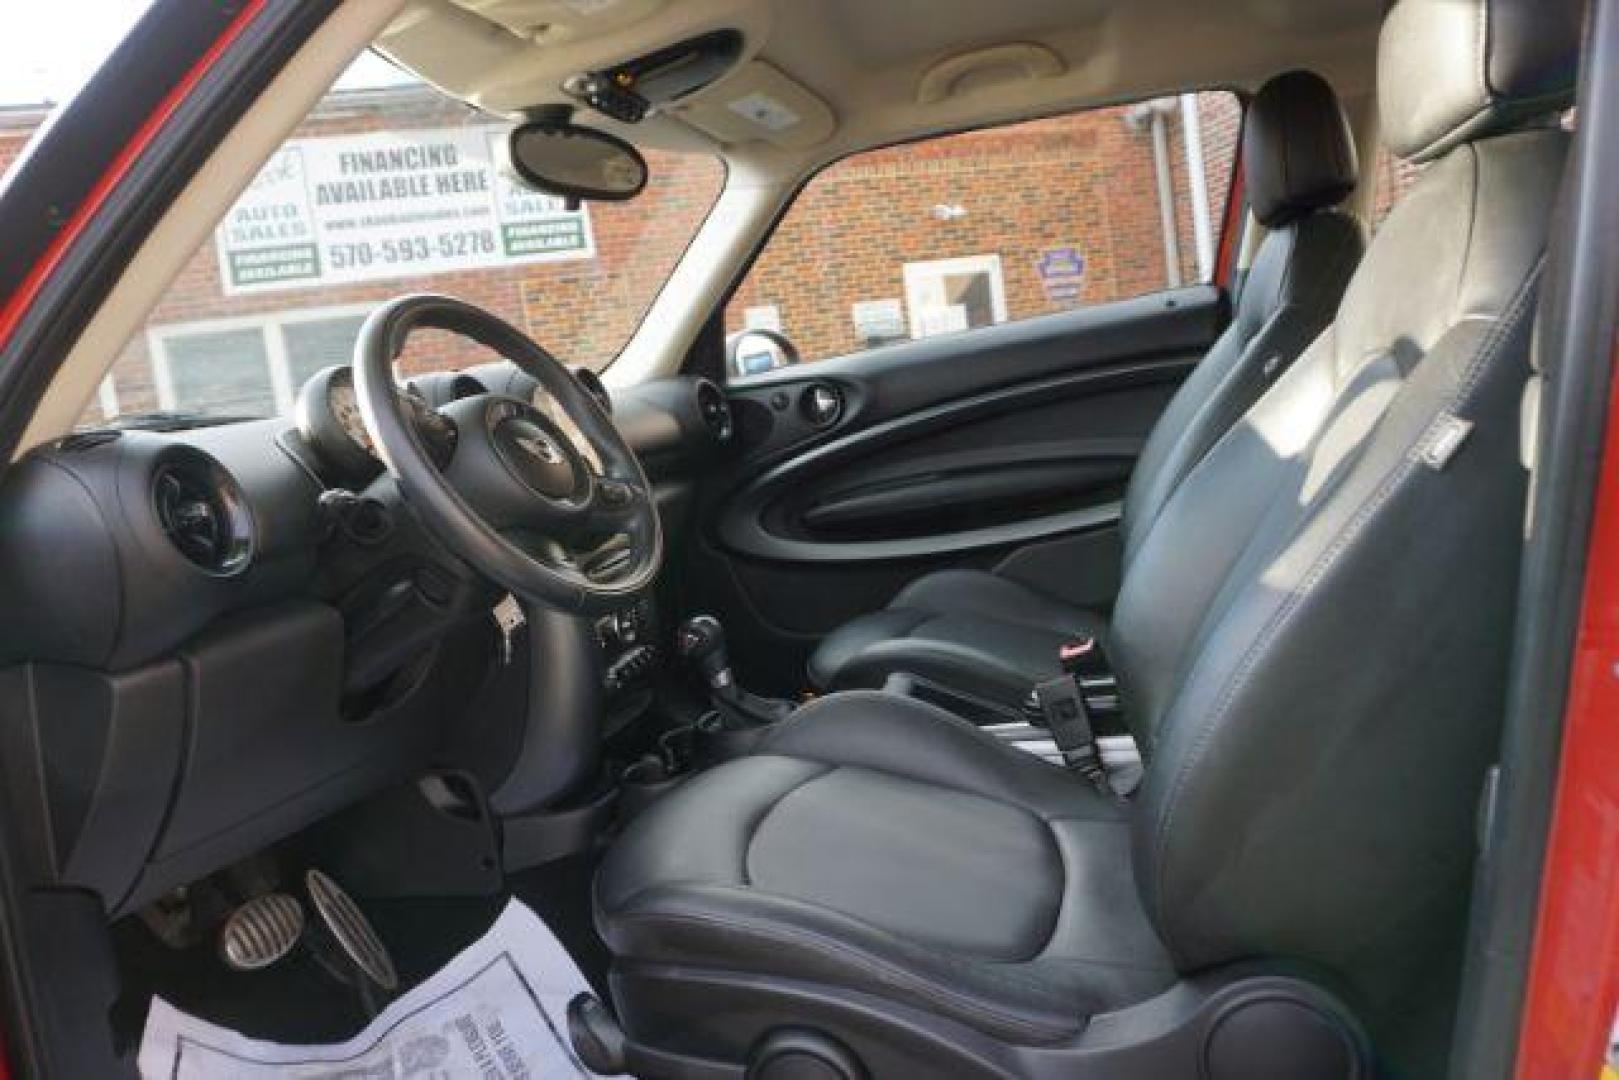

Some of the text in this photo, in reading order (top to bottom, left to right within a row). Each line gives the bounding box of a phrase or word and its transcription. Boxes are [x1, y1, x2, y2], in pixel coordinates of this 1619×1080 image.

[339, 143, 458, 174] FINANCING
[316, 168, 489, 205] AVAILABLE HERE
[236, 203, 298, 223] AUTO
[232, 219, 307, 241] SALES
[328, 229, 496, 270] 570-593-5278
